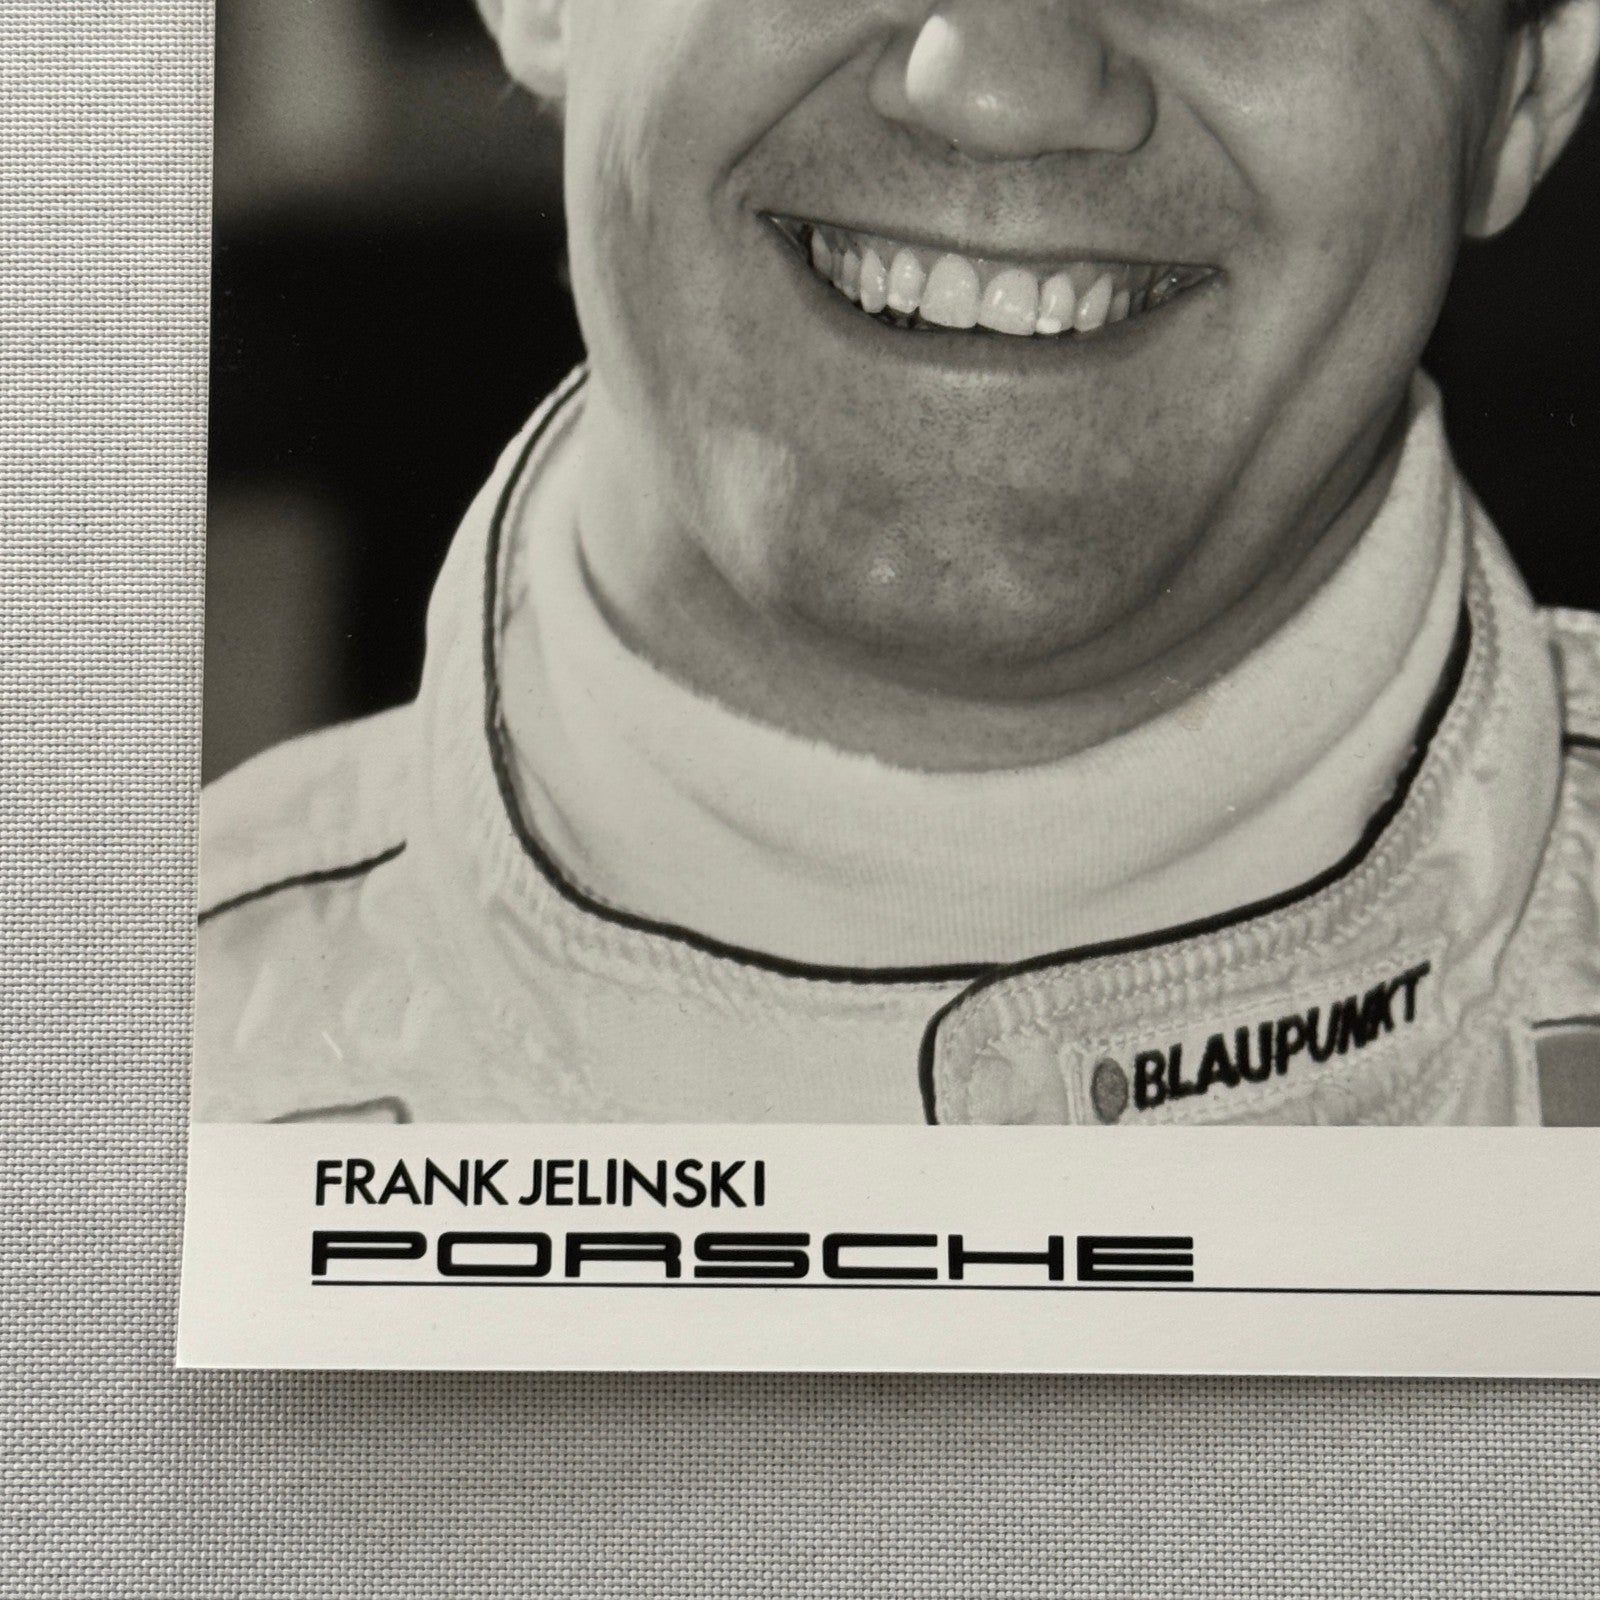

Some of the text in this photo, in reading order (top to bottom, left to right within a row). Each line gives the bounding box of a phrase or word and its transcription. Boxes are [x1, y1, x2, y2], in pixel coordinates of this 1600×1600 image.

[1133, 961, 1431, 1112] BLAUPUNKT
[315, 1157, 766, 1209] FRANK JELINSKI
[311, 1230, 1195, 1283] PORSCHE
